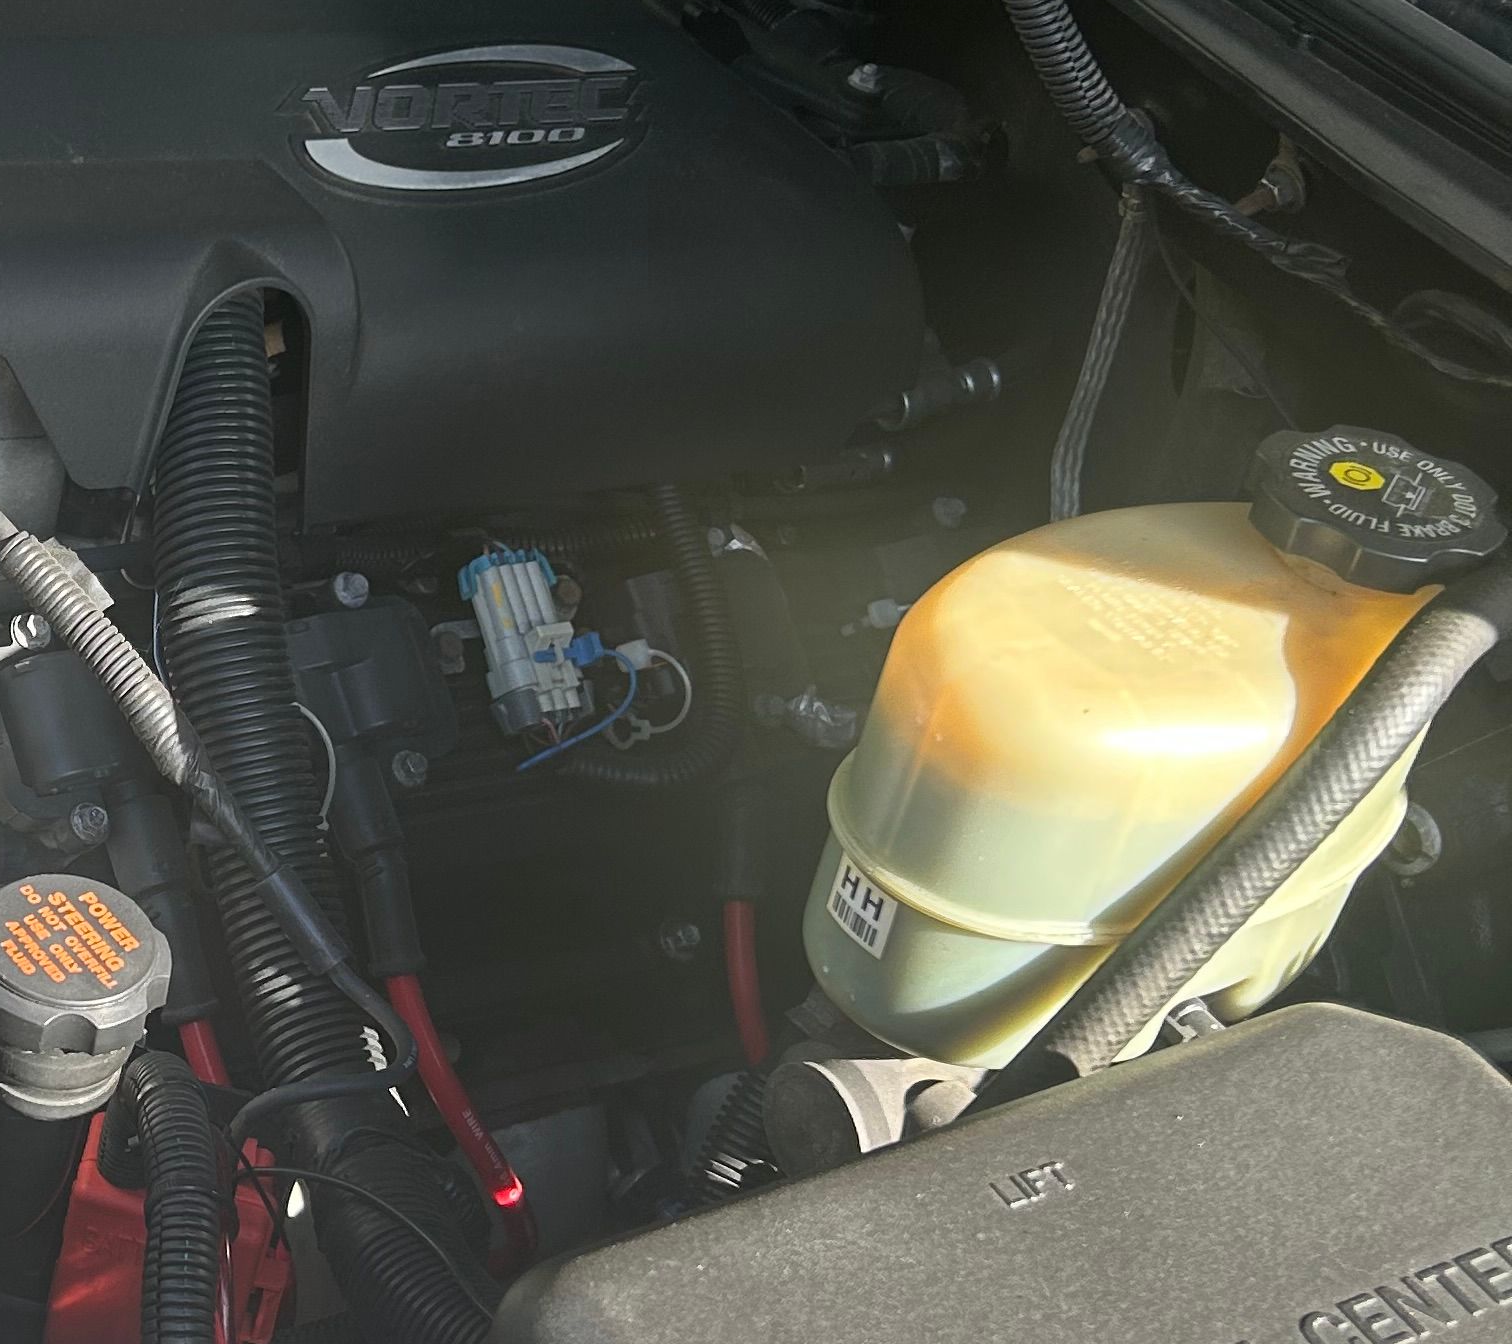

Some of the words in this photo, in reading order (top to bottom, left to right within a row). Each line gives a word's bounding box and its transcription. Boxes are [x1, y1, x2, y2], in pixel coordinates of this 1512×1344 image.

[301, 76, 631, 133] VORTEC
[445, 125, 586, 148] 8100
[1288, 435, 1357, 499] WARNING
[1371, 440, 1415, 463] USE
[1415, 459, 1467, 491] ONLY
[1326, 502, 1390, 533] FLUID
[1396, 518, 1460, 539] BRAKE
[1450, 492, 1477, 519] DOT
[20, 885, 41, 904] DO
[38, 906, 67, 930] NOT
[65, 929, 117, 989] OVERFILL
[24, 914, 51, 940] USE
[50, 944, 82, 972] ONLY
[48, 892, 124, 979] STEERING
[79, 892, 139, 951] POWER
[1, 939, 36, 974] FLUID
[5, 922, 65, 982] APPROVED
[989, 1159, 1076, 1209] LIFT
